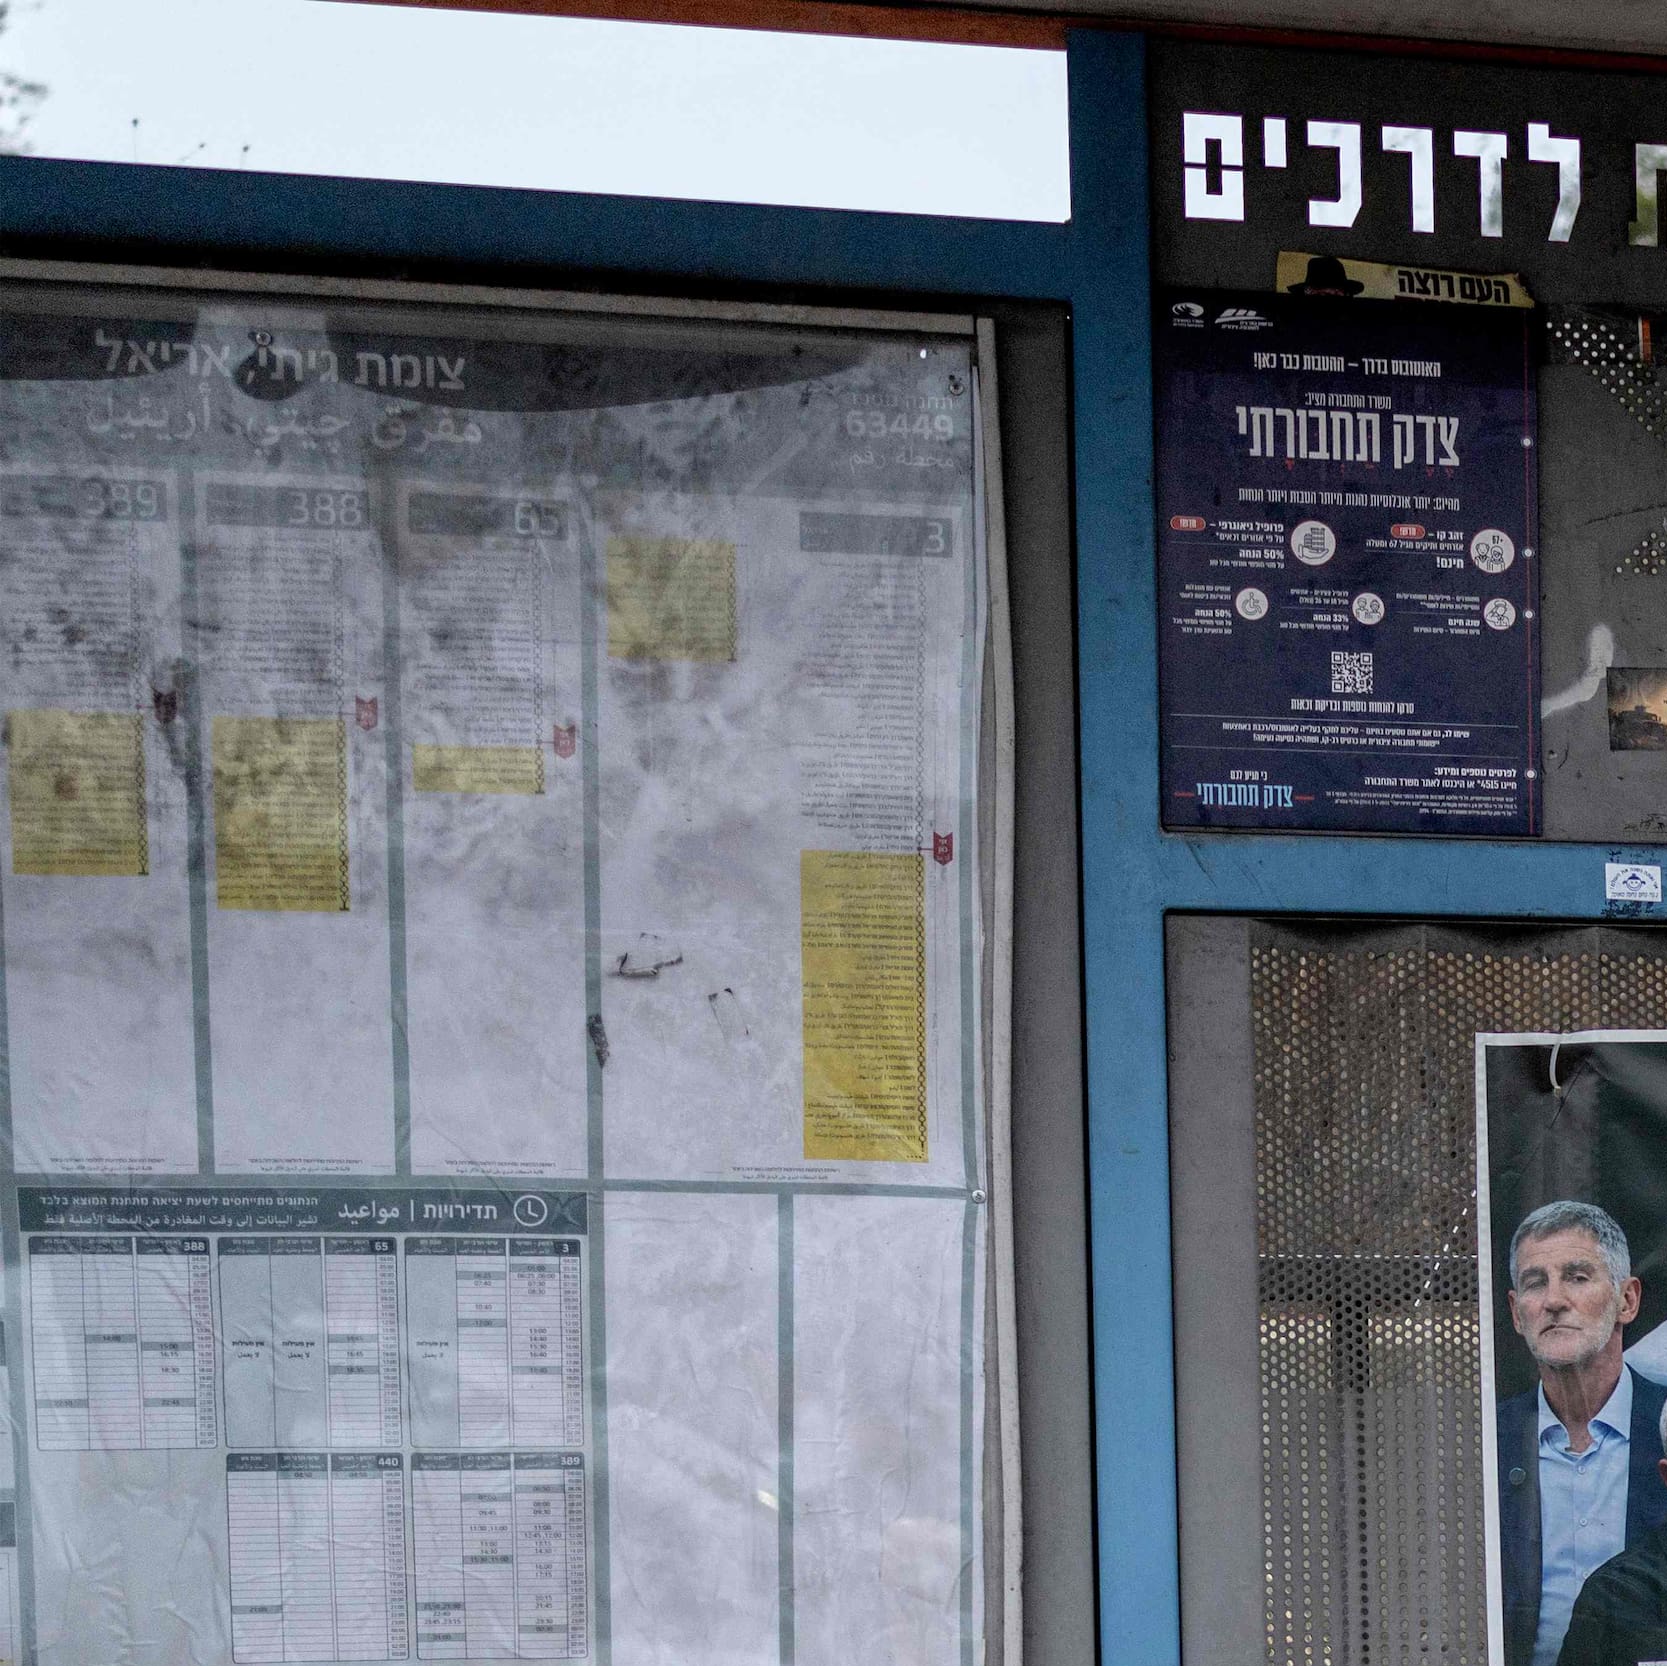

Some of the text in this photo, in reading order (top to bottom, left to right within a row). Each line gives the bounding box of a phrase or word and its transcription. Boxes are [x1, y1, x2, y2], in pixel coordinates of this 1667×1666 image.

[1183, 110, 1582, 243] לדרכים
[1397, 268, 1511, 304] העם רוצה
[94, 328, 230, 377] אריאל
[354, 351, 466, 391] צומת
[1253, 352, 1442, 378] האוטובוס בדרך ההטבות כבר כאן!
[1327, 393, 1392, 411] משרד התחבורה
[846, 410, 954, 442] 63449
[1235, 405, 1460, 470] צדק תחבורתי
[1238, 488, 1264, 503] הנחות
[1266, 490, 1288, 505] ויותר
[1289, 491, 1317, 507] הטבות
[1318, 492, 1344, 508] מיותר
[1345, 493, 1368, 508] נהנות
[1369, 494, 1412, 510] אוכלוסיות
[1412, 495, 1431, 510] יותר
[289, 491, 363, 526] 388
[1218, 520, 1284, 533] פרופיל גיאוגרפי
[925, 521, 945, 554] 3
[1365, 538, 1465, 552] אזרחים ותיקים מגיל 67 ומעלה
[1238, 548, 1285, 560] 50% הנחה
[1435, 555, 1465, 569] חינם!
[1314, 699, 1341, 713] ובדיקת
[1341, 701, 1367, 713] נוספות
[1368, 700, 1396, 714] להנחות
[1396, 702, 1415, 715] סרקו
[1229, 769, 1243, 780] לכם
[1244, 769, 1260, 781] מגיע
[1434, 766, 1518, 779] לפרטים נוספים ומידע:
[1363, 776, 1398, 787] התחבורה
[1398, 777, 1420, 787] משרד
[1419, 777, 1441, 788] לאתר
[1441, 778, 1466, 788] היכנסו
[1466, 779, 1476, 789] או
[1195, 782, 1294, 809] צדק תחבורתי
[40, 1196, 69, 1206] בלבד
[72, 1196, 107, 1206] המוצא
[153, 1196, 183, 1206] יציאה
[186, 1194, 219, 1206] לשעת
[222, 1195, 273, 1206] מתייחסים
[277, 1195, 319, 1206] הנתונים
[338, 1199, 401, 1223] مواعيد
[424, 1202, 498, 1221] תדירויות
[184, 1241, 205, 1251] 388
[374, 1242, 388, 1251] 65
[563, 1244, 569, 1252] 3
[378, 1457, 398, 1466] 440
[560, 1457, 580, 1465] 389
